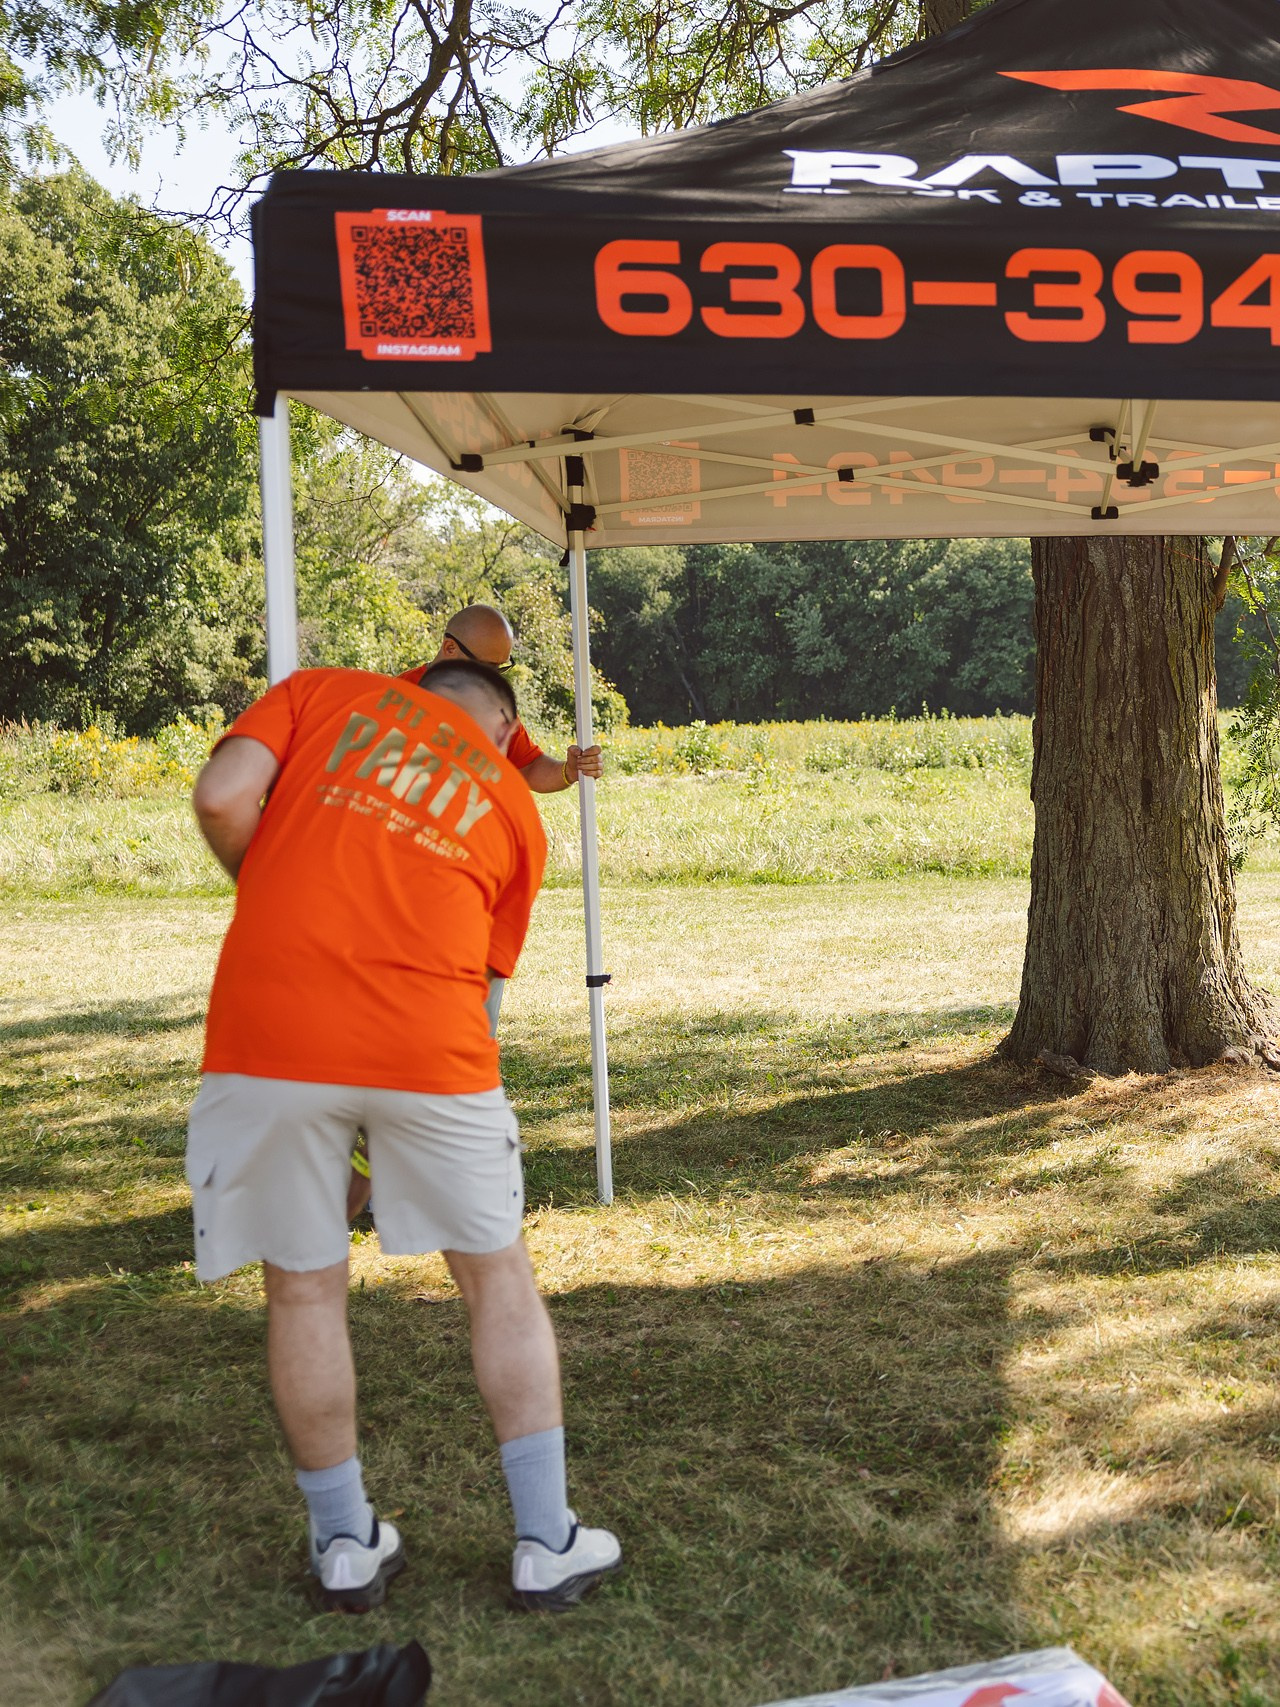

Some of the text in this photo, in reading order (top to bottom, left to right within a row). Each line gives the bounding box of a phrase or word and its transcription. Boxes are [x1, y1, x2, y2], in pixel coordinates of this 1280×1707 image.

[1018, 190, 1063, 207] &
[387, 210, 432, 222] SCAN
[377, 344, 461, 357] INSTAGRAM
[376, 687, 503, 784] PIT STOP
[325, 711, 493, 838] PARTY
